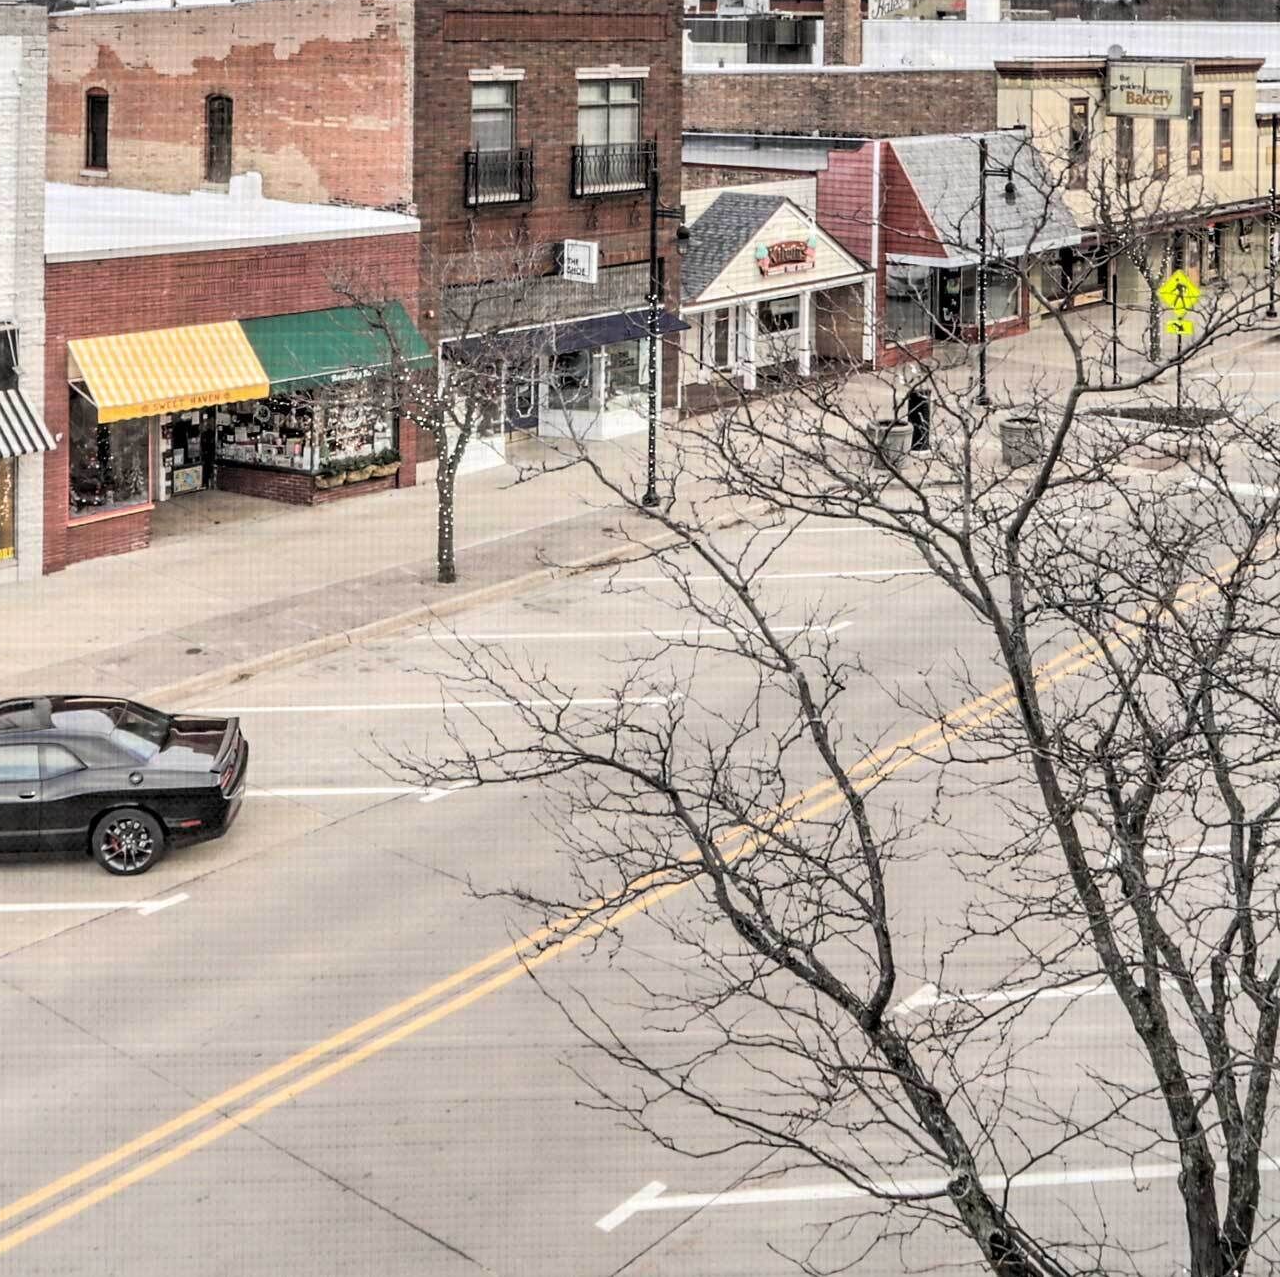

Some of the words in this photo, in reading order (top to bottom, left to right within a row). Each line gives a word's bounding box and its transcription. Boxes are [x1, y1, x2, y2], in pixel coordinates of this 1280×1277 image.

[1125, 91, 1173, 107] Bakery
[153, 399, 184, 410] SWEET
[191, 394, 220, 404] HAVEN
